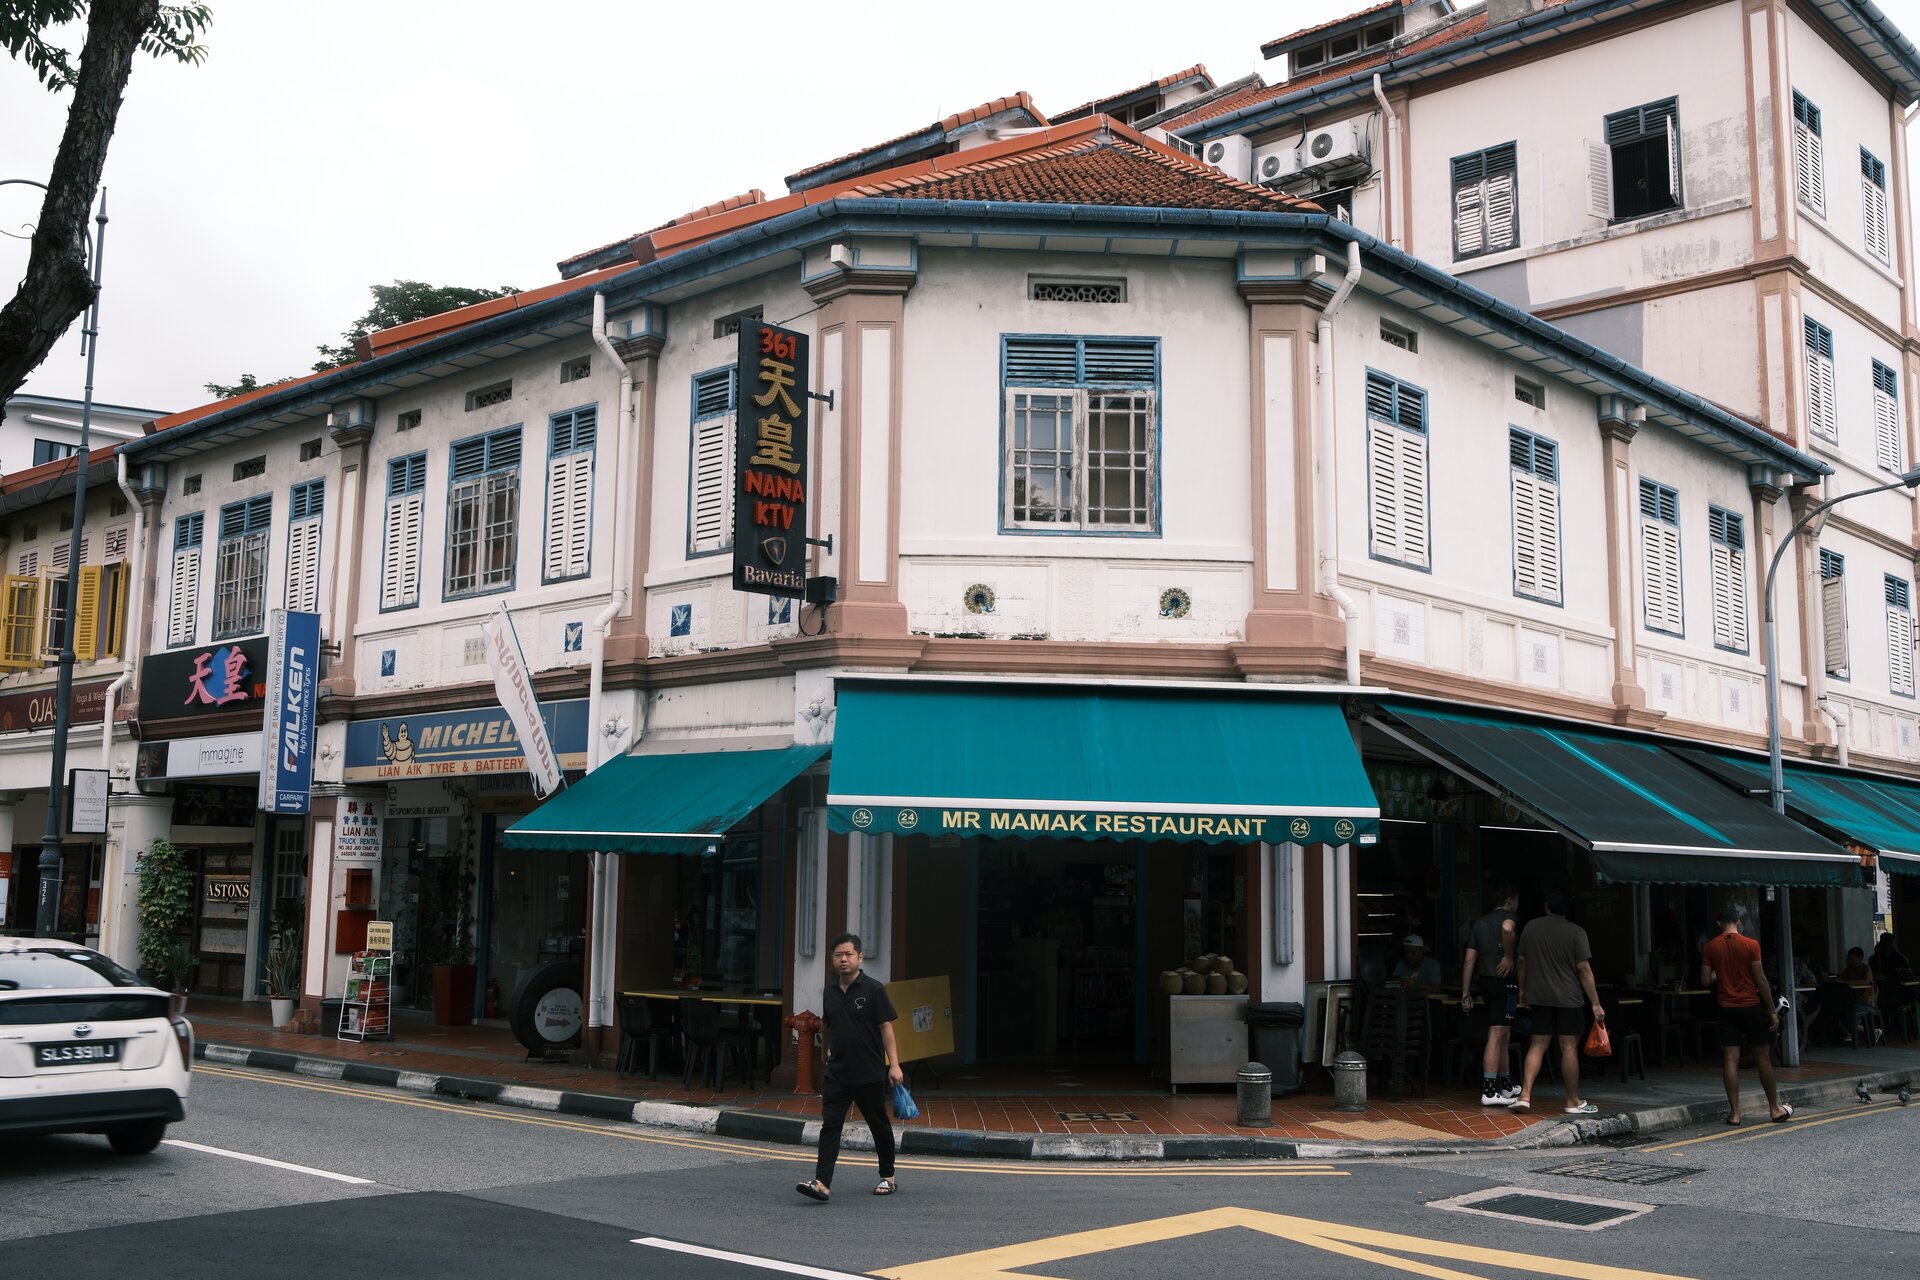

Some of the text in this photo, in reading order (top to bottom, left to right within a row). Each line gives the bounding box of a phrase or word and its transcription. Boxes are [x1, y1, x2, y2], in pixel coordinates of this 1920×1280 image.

[758, 326, 797, 360] 361
[750, 358, 802, 475] 天皇
[743, 469, 805, 503] NANA
[754, 501, 796, 530] KTV
[743, 565, 805, 588] Bavaria
[276, 626, 284, 658] BATTERY
[184, 646, 249, 705] 天皇
[274, 667, 282, 689] TYRES
[93, 690, 106, 701] Well
[272, 705, 280, 721] LIAN
[284, 646, 305, 773] FALKEN
[299, 666, 312, 754] High Performance Tyres
[418, 718, 521, 749] MICHEL
[378, 766, 400, 777] LIAN
[429, 762, 456, 774] TYRE
[462, 761, 469, 772] &
[475, 758, 525, 772] BATTERY
[280, 793, 304, 801] CARPARK
[388, 805, 451, 816] RESPONSIBLE BEAUTY
[900, 812, 915, 821] 24
[342, 826, 377, 837] LIAN AIK
[942, 810, 1267, 836] MR MAMAK RESTAURANT
[1293, 821, 1308, 831] 24
[339, 837, 356, 845] TRUCK
[206, 883, 250, 898] ASTONS
